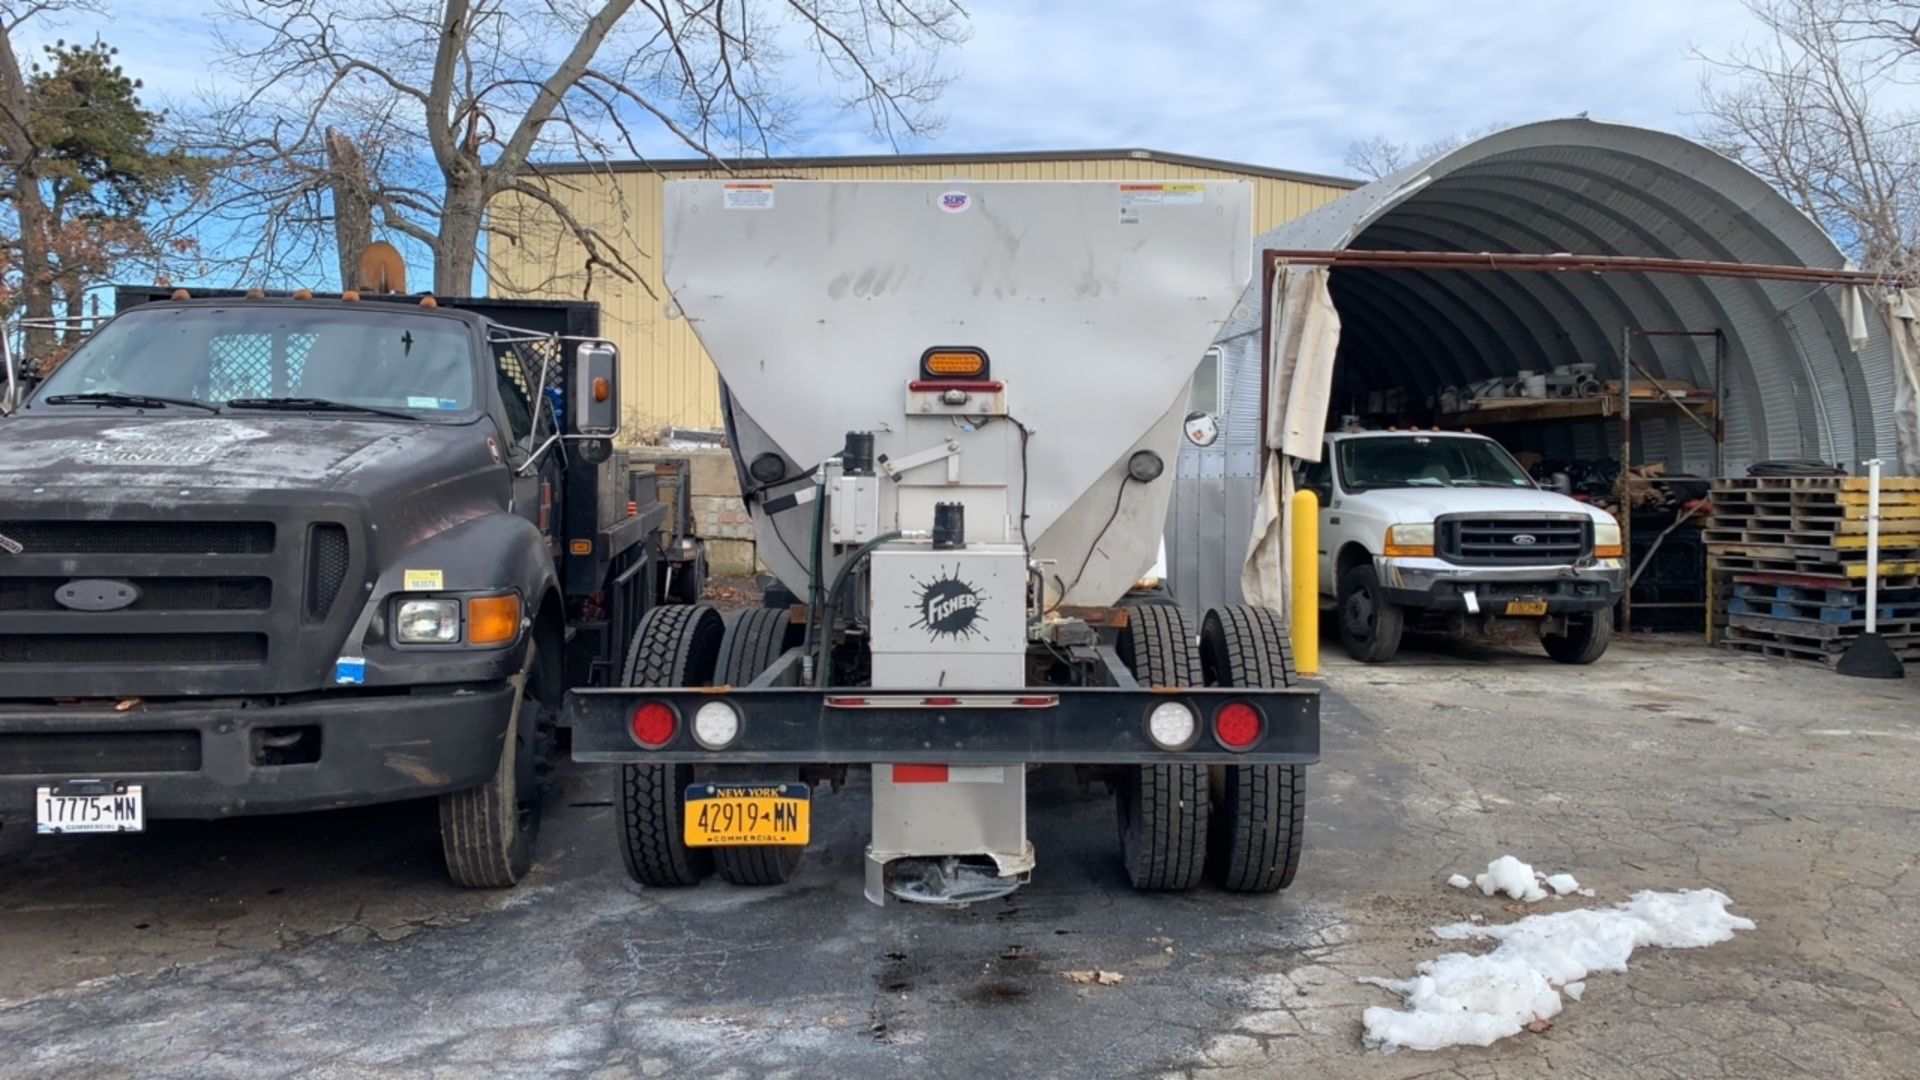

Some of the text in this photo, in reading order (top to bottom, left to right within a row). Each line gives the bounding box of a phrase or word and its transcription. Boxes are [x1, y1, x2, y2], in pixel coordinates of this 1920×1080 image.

[717, 788, 779, 798] NEW YORK
[713, 835, 779, 843] COMMERCIAL
